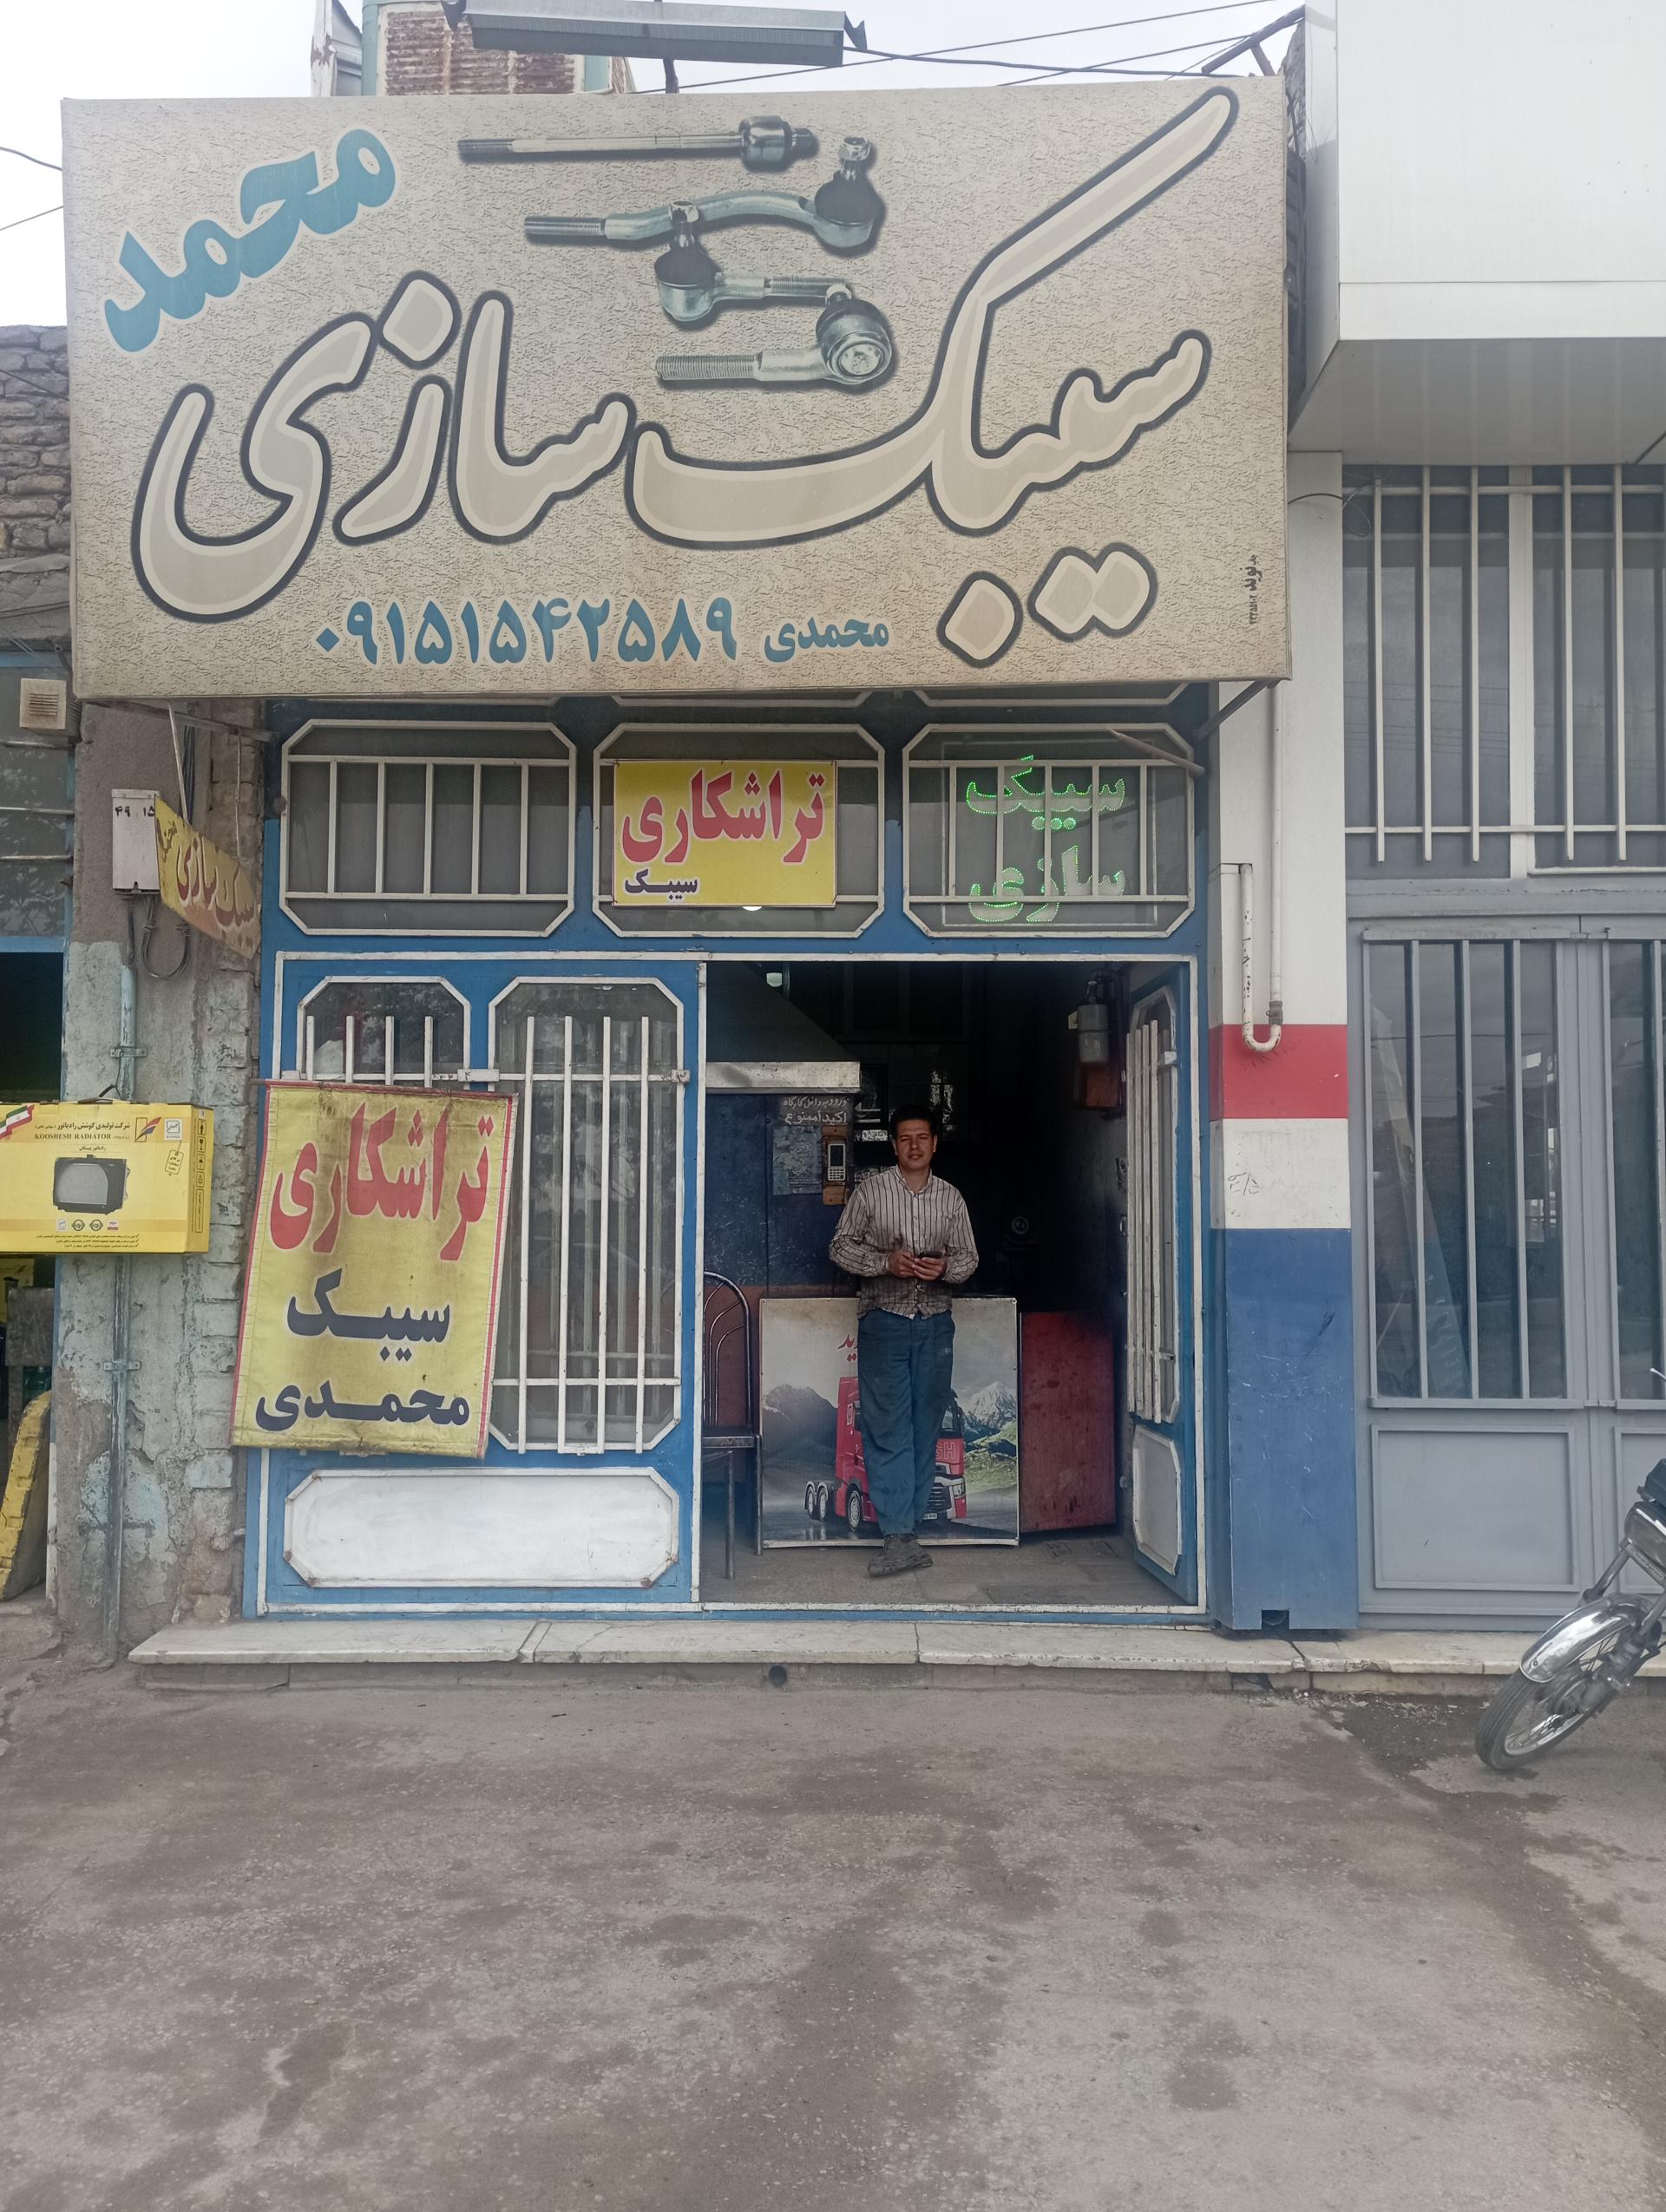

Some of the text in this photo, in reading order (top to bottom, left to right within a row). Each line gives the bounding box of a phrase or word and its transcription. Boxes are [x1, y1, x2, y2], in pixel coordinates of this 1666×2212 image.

[103, 128, 397, 352] محمد
[131, 86, 1239, 668] سیبک سازی
[1239, 566, 1263, 592] نوید
[314, 597, 890, 666] محمدی ۰۹۱۵۱۵۴۲۵۸۹
[622, 769, 825, 863] تراشکاری
[625, 868, 698, 900] سیبک
[56, 1122, 77, 1130] رادیاتور
[95, 1122, 114, 1130] تولیدی
[269, 1101, 495, 1261] تراشکاری
[287, 1267, 450, 1362] سیبک
[255, 1380, 470, 1431] محمدی
